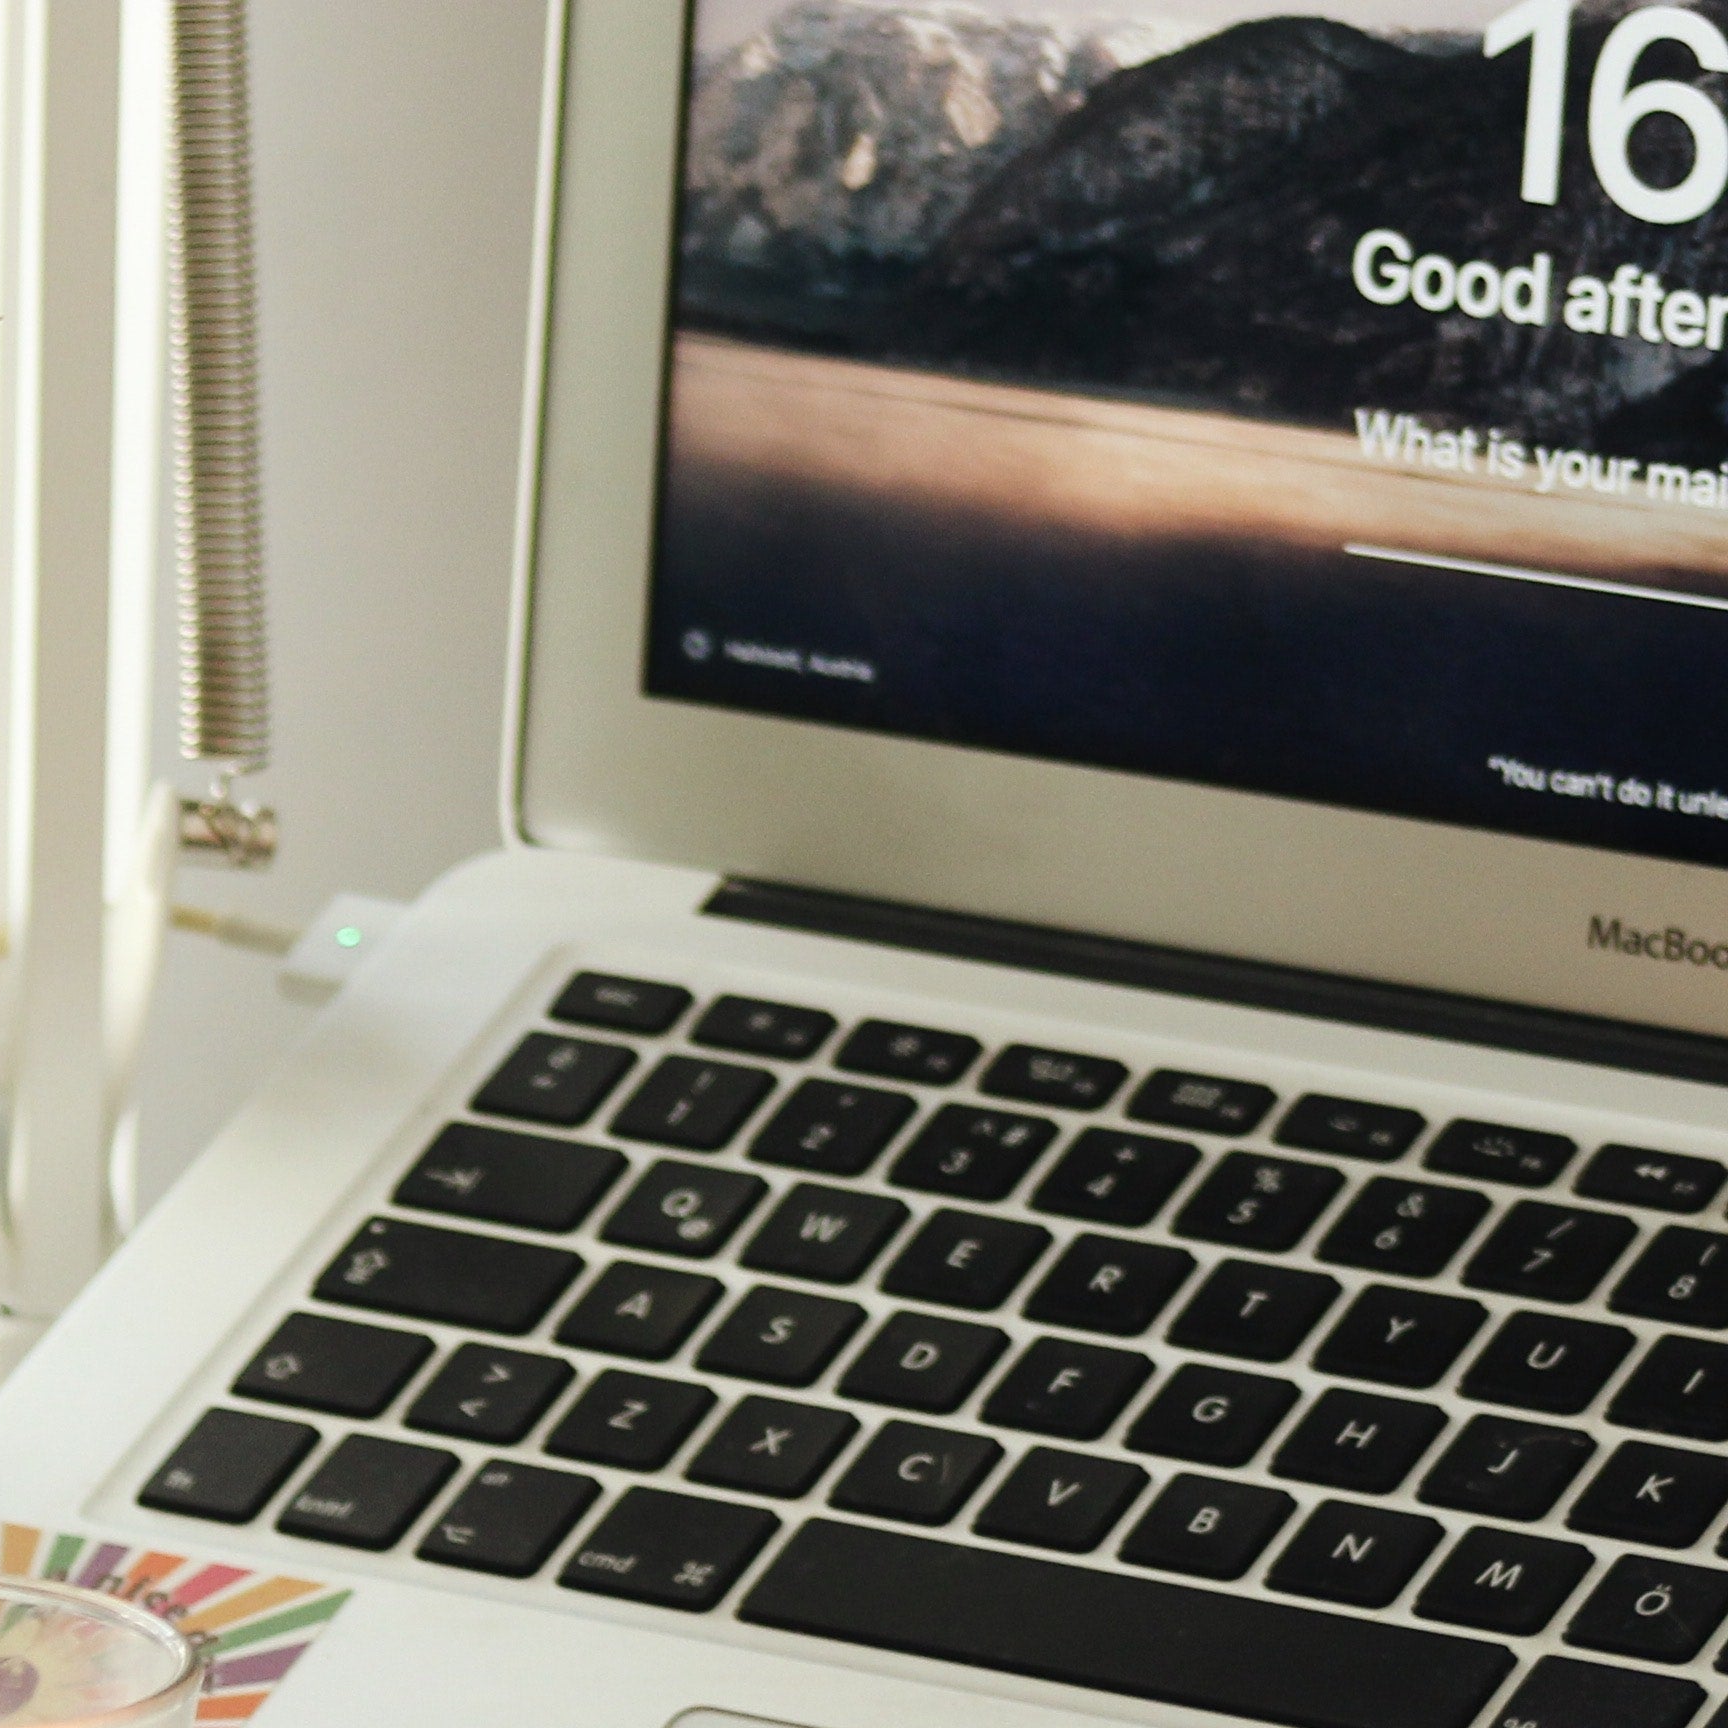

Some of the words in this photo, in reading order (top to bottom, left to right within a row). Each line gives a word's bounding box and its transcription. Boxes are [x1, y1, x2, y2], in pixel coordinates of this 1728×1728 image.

[1352, 228, 1552, 328] Good
[1562, 263, 1728, 352] after
[1352, 407, 1479, 474] What
[1486, 427, 1526, 480] is
[1533, 446, 1641, 496] your
[1617, 778, 1653, 807] do
[1655, 784, 1677, 810] it
[661, 1188, 699, 1219] Q
[1228, 1200, 1258, 1224] 5
[800, 1214, 846, 1242] W
[1374, 1227, 1399, 1250] 6
[946, 1239, 979, 1268] E
[1524, 1249, 1553, 1271] 7
[1090, 1265, 1123, 1292] R
[1668, 1275, 1697, 1299] 8
[617, 1291, 651, 1319] A
[1240, 1291, 1268, 1316] T
[761, 1316, 794, 1344] S
[1386, 1317, 1414, 1342] Y
[900, 1341, 939, 1370] D
[1526, 1342, 1566, 1370] U
[1048, 1368, 1081, 1393] F
[1683, 1369, 1704, 1394] I
[608, 1401, 647, 1429] Z
[1192, 1396, 1229, 1423] G
[751, 1427, 789, 1455] X
[1336, 1420, 1377, 1448] H
[898, 1453, 934, 1482] C
[1487, 1449, 1519, 1474] J
[1047, 1479, 1080, 1506] V
[1636, 1474, 1674, 1502] K
[1187, 1506, 1221, 1534] B
[577, 1546, 638, 1575] cmd
[1332, 1533, 1374, 1562] N
[1475, 1560, 1523, 1590] M
[1634, 1578, 1674, 1617] Ö
